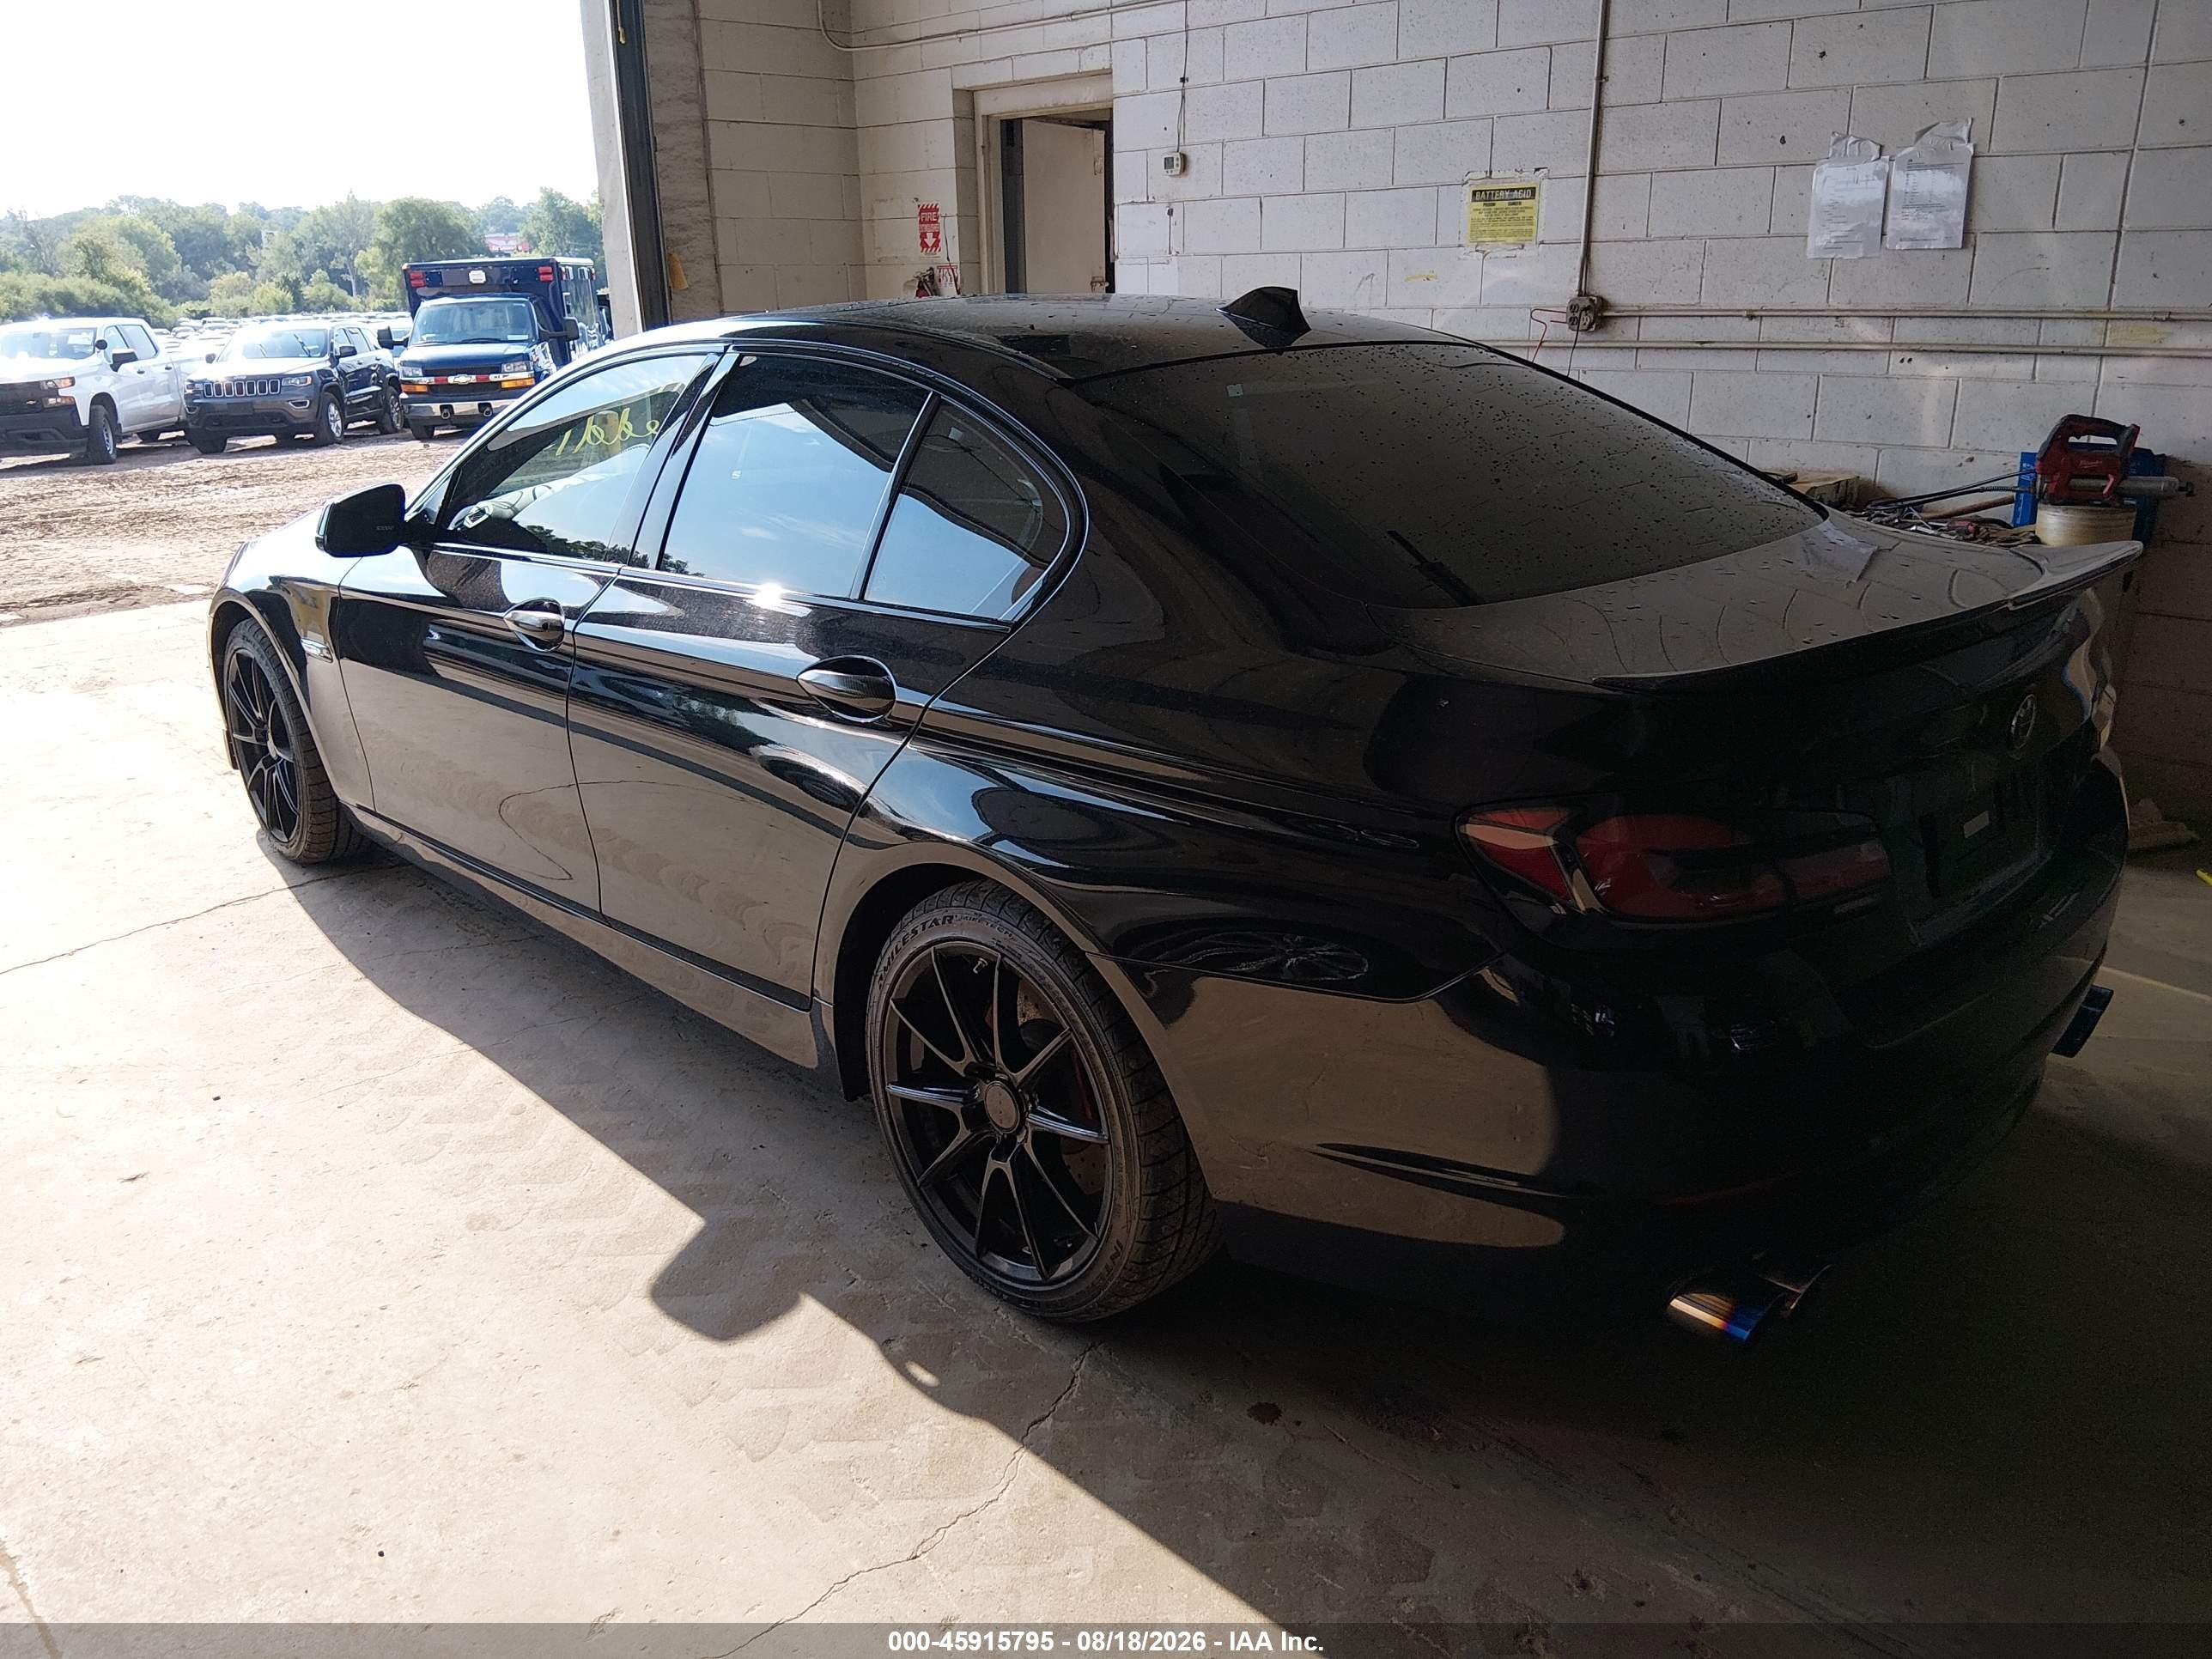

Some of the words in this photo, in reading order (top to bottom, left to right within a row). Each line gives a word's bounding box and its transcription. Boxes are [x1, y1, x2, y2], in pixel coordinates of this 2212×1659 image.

[1475, 190, 1510, 200] BATTERY
[1513, 189, 1532, 199] ACID
[921, 212, 938, 222] FIRE
[881, 915, 954, 972] MILESTAR
